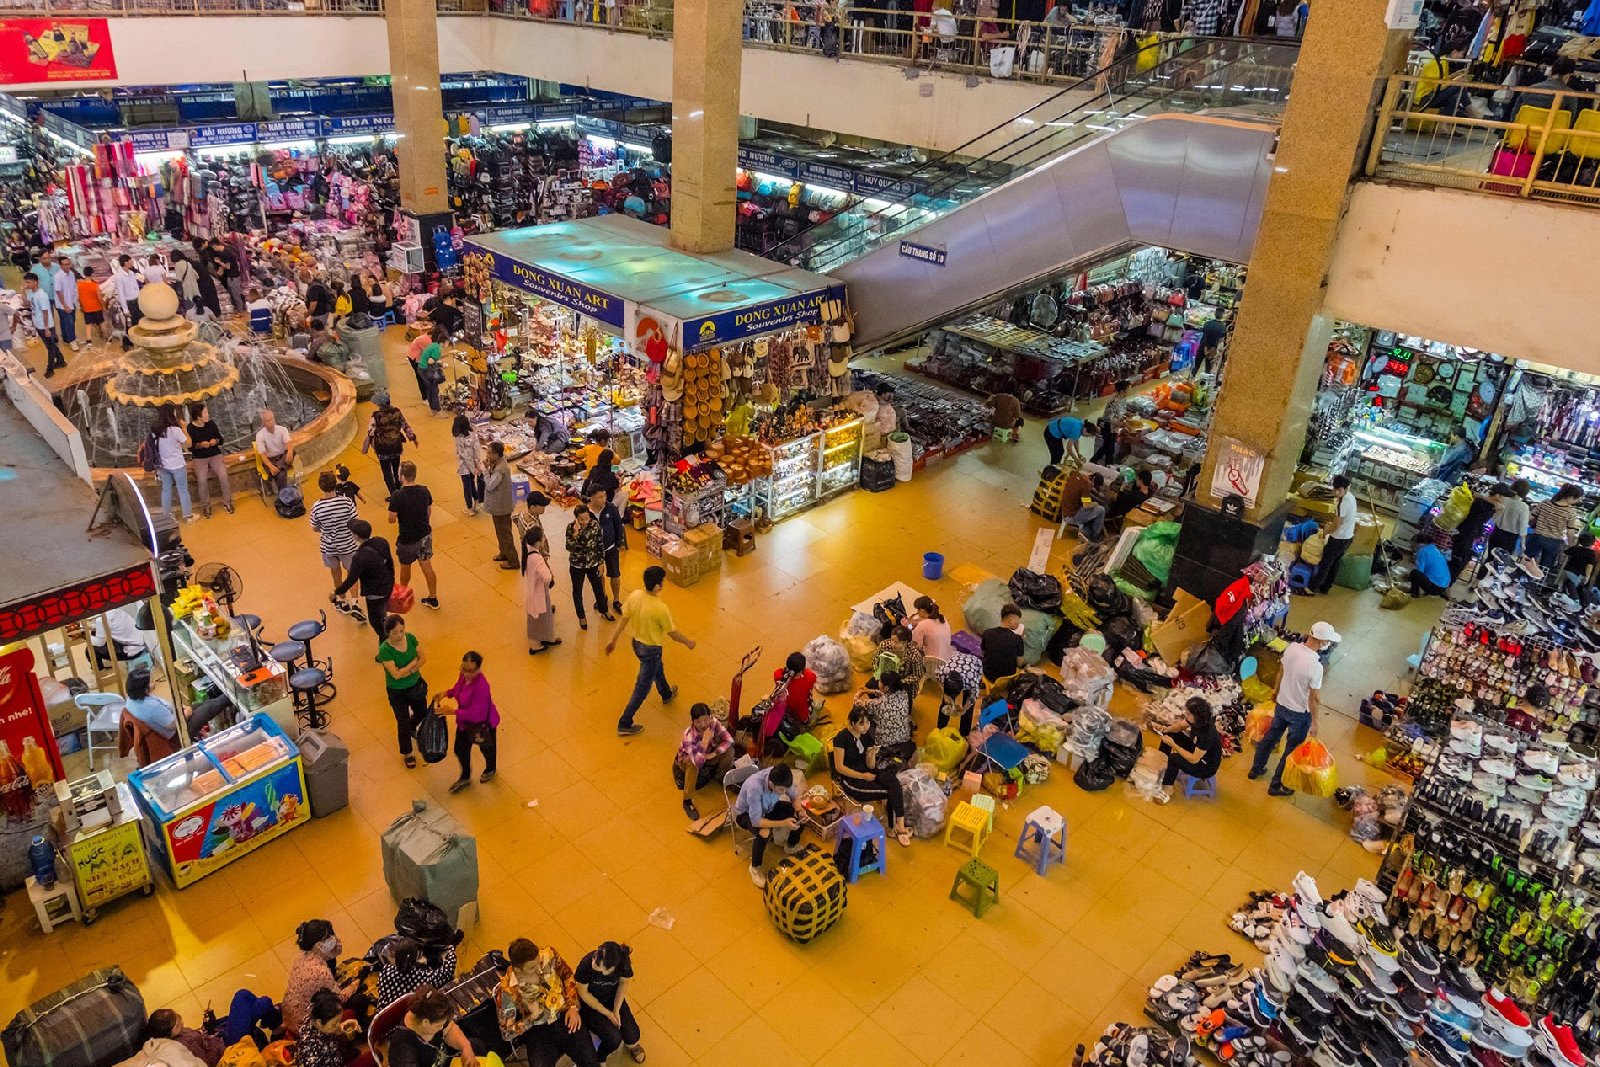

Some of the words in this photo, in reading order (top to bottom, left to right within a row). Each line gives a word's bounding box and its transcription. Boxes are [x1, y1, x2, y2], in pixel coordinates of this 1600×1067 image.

[341, 118, 369, 127] HOA
[513, 264, 546, 286] DONG
[548, 277, 582, 299] XUAN
[585, 293, 609, 310] ART
[523, 278, 569, 302] Souvenirs
[570, 295, 598, 313] Shop
[735, 307, 771, 327] DONG
[773, 301, 806, 318] XUAN
[745, 313, 794, 333] Souvenirs
[794, 308, 819, 322] Shop
